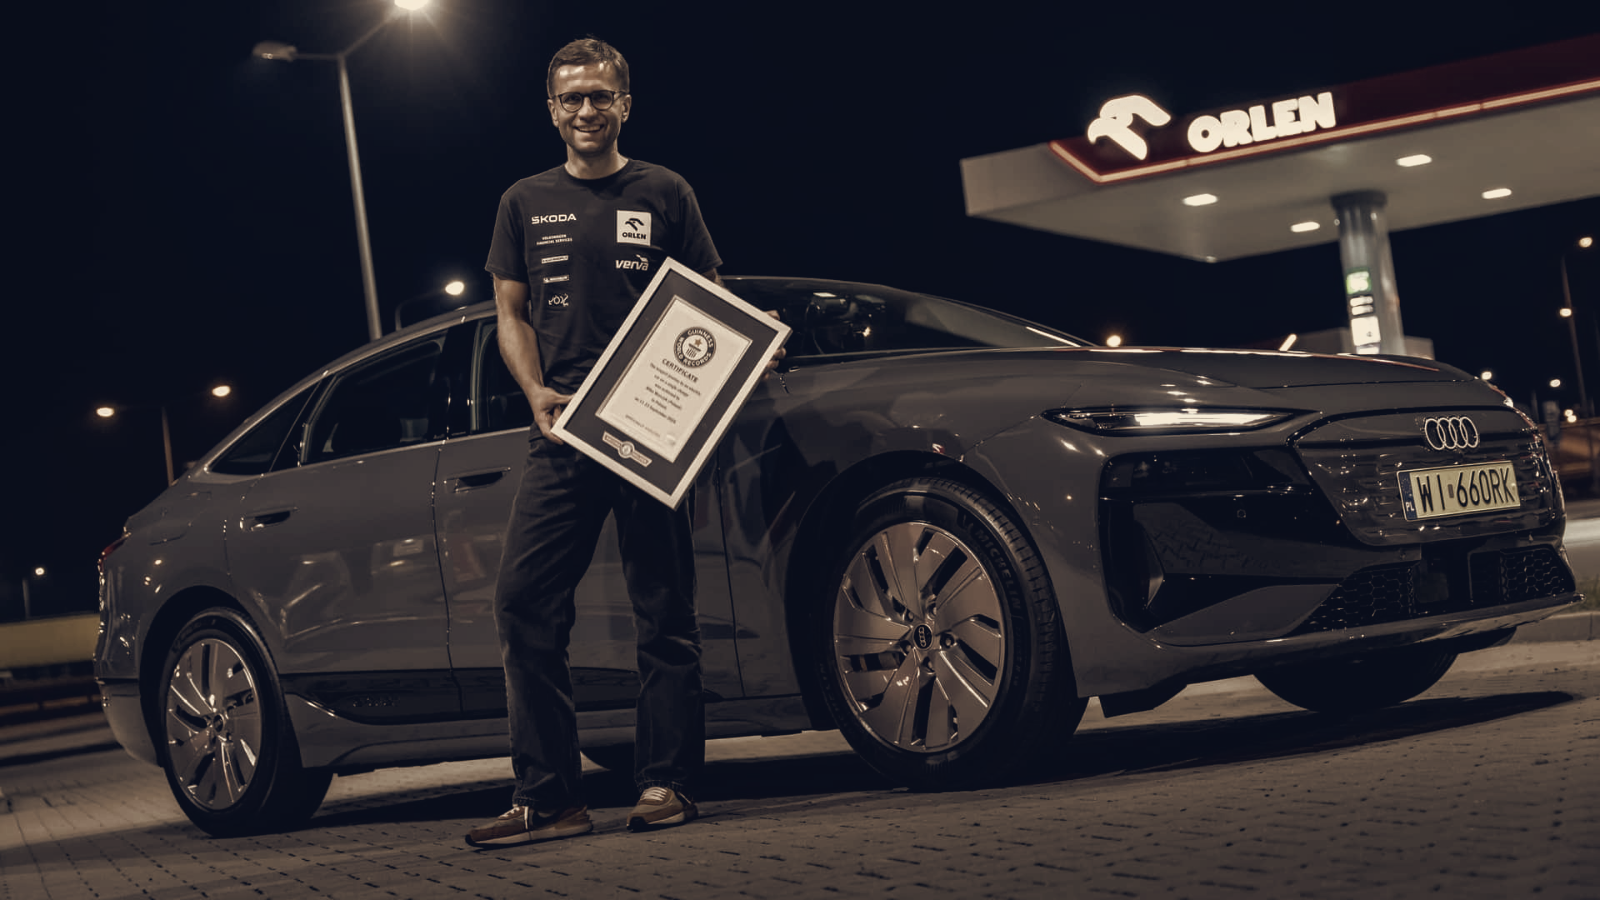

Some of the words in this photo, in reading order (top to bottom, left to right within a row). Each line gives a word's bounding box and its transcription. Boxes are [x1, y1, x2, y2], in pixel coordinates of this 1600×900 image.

[1187, 92, 1337, 153] ORLEN
[622, 232, 647, 240] ORLEN
[615, 256, 649, 271] verva
[675, 337, 686, 360] WORLD
[687, 329, 714, 349] GUINNESS
[683, 352, 713, 366] RECORDS
[662, 358, 699, 384] CERTIFICATE
[1416, 474, 1445, 512] WI
[1457, 468, 1515, 507] 660RK
[1405, 502, 1415, 512] PL
[974, 528, 1022, 612] MICHELIN
